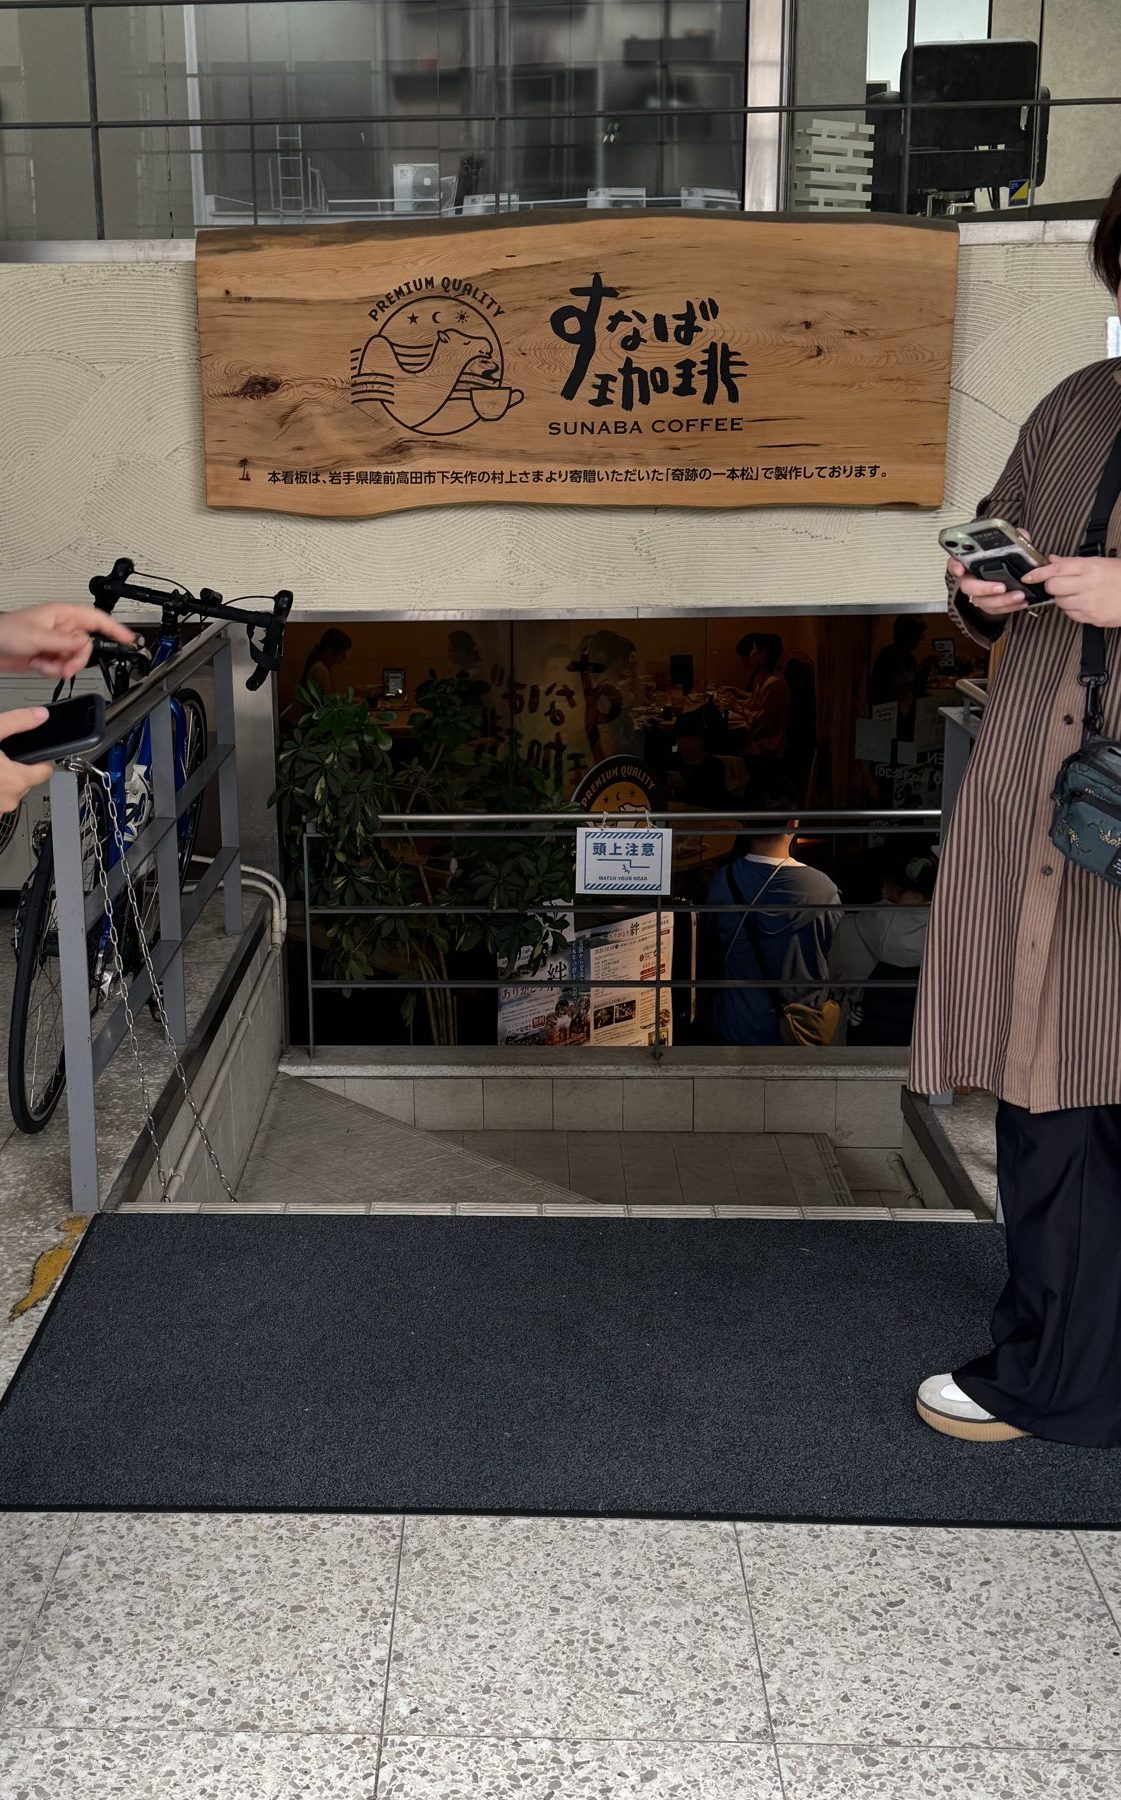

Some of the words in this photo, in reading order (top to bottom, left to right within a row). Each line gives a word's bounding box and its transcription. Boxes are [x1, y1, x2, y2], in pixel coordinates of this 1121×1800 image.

[368, 276, 435, 322] PREMIUM
[441, 276, 505, 319] QUALITY
[550, 272, 719, 400] すなば
[588, 342, 749, 411] 珈琲
[548, 421, 643, 436] SUNABA
[651, 417, 744, 434] COFFEE
[267, 464, 888, 485] 本看板は、岩手県陸前高田市下矢作の村上さまより寄贈いただいた「奇跡の一本松」で製作しております。
[580, 766, 618, 807] PREMIUM
[620, 763, 657, 792] QUALITY
[592, 842, 655, 856] 頭上注意
